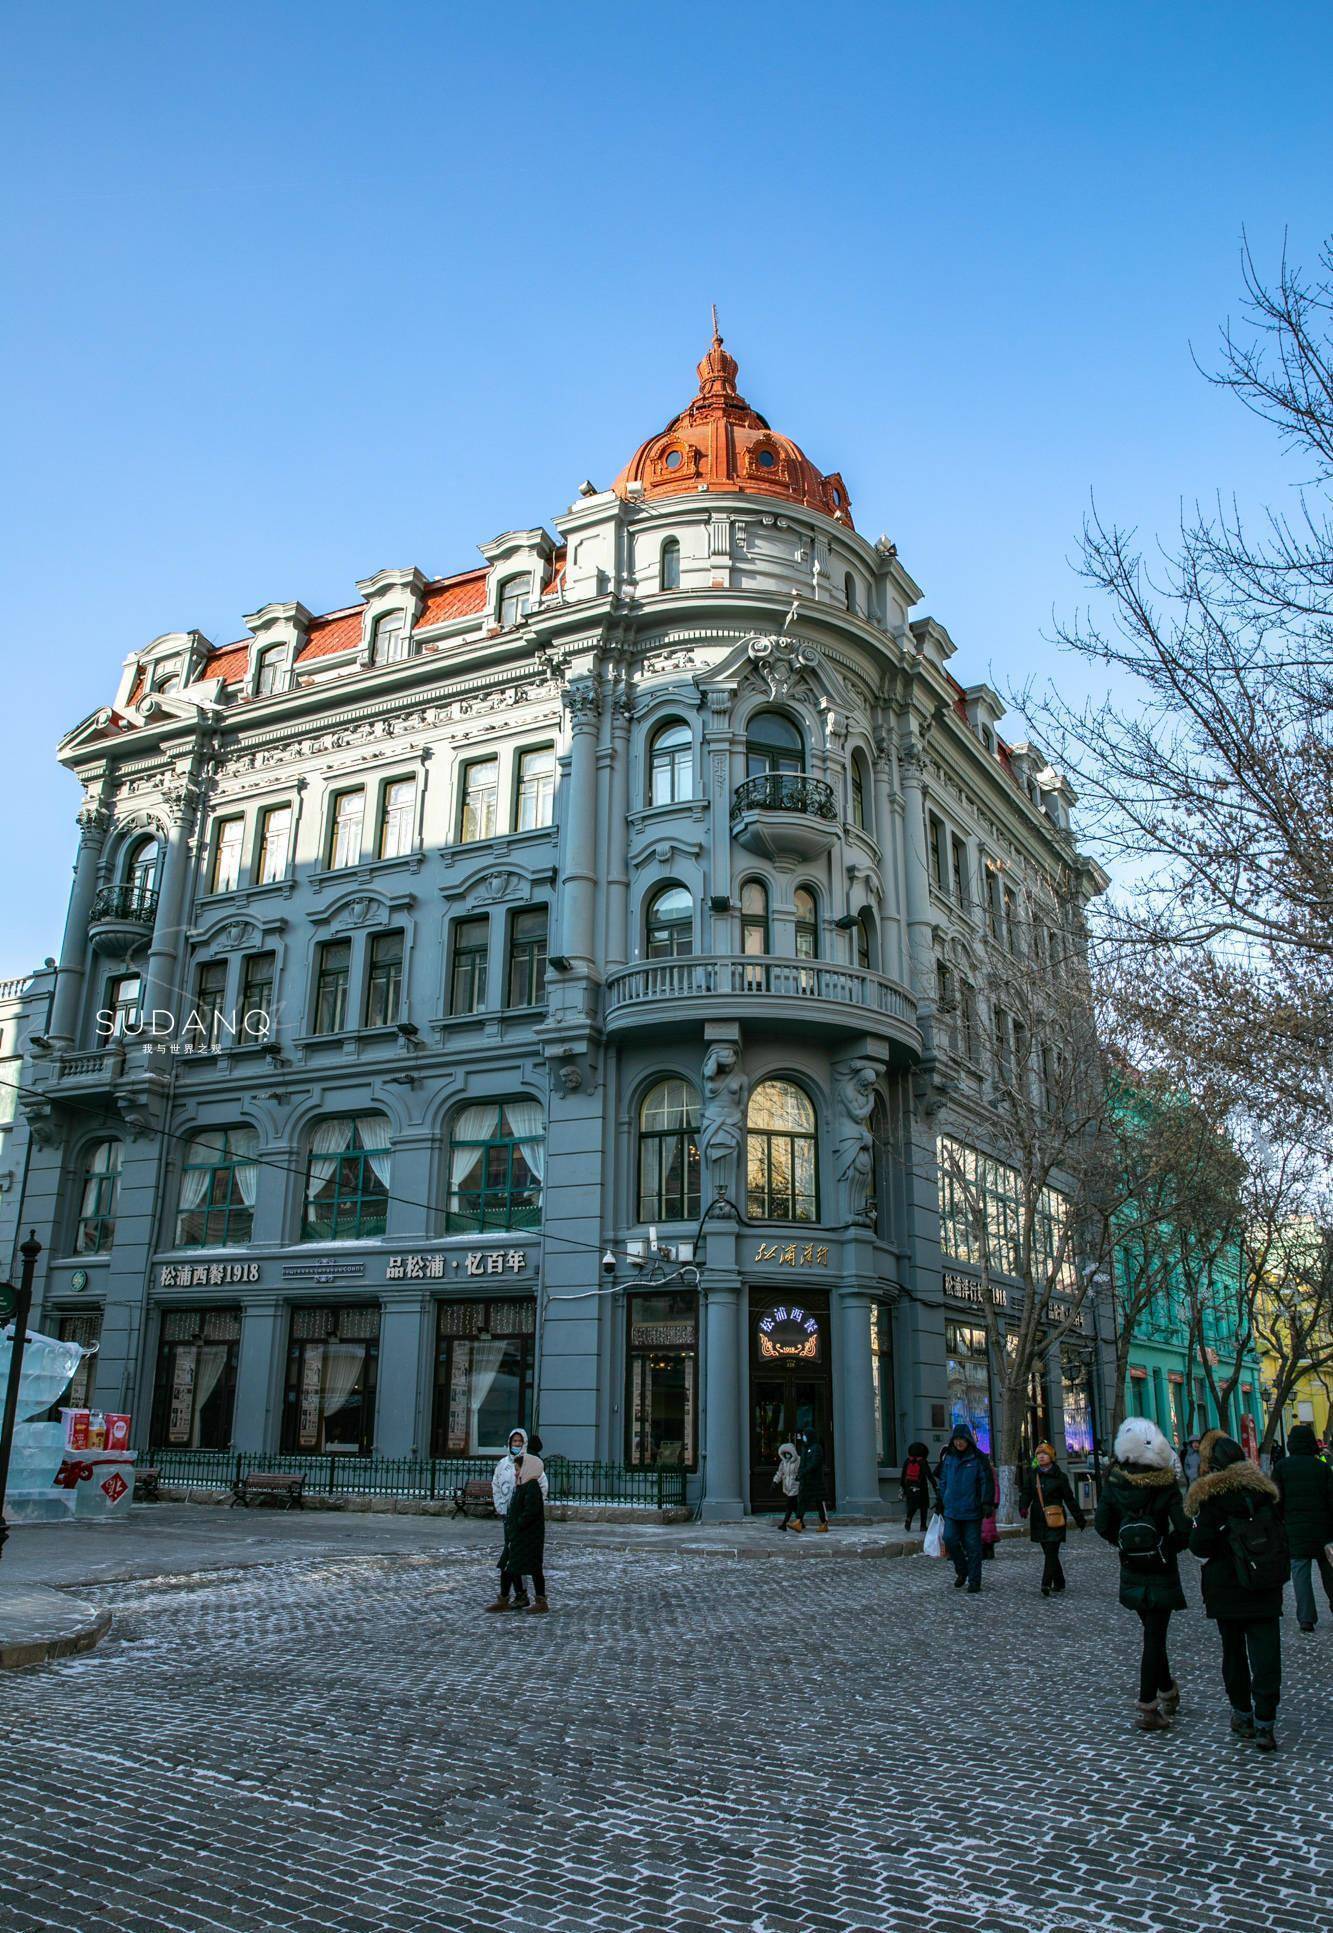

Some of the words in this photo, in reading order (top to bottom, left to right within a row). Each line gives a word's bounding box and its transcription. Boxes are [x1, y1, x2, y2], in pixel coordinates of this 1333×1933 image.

[160, 1263, 260, 1287] 松浦西餐1918
[386, 1250, 526, 1279] 品松浦·忆百年
